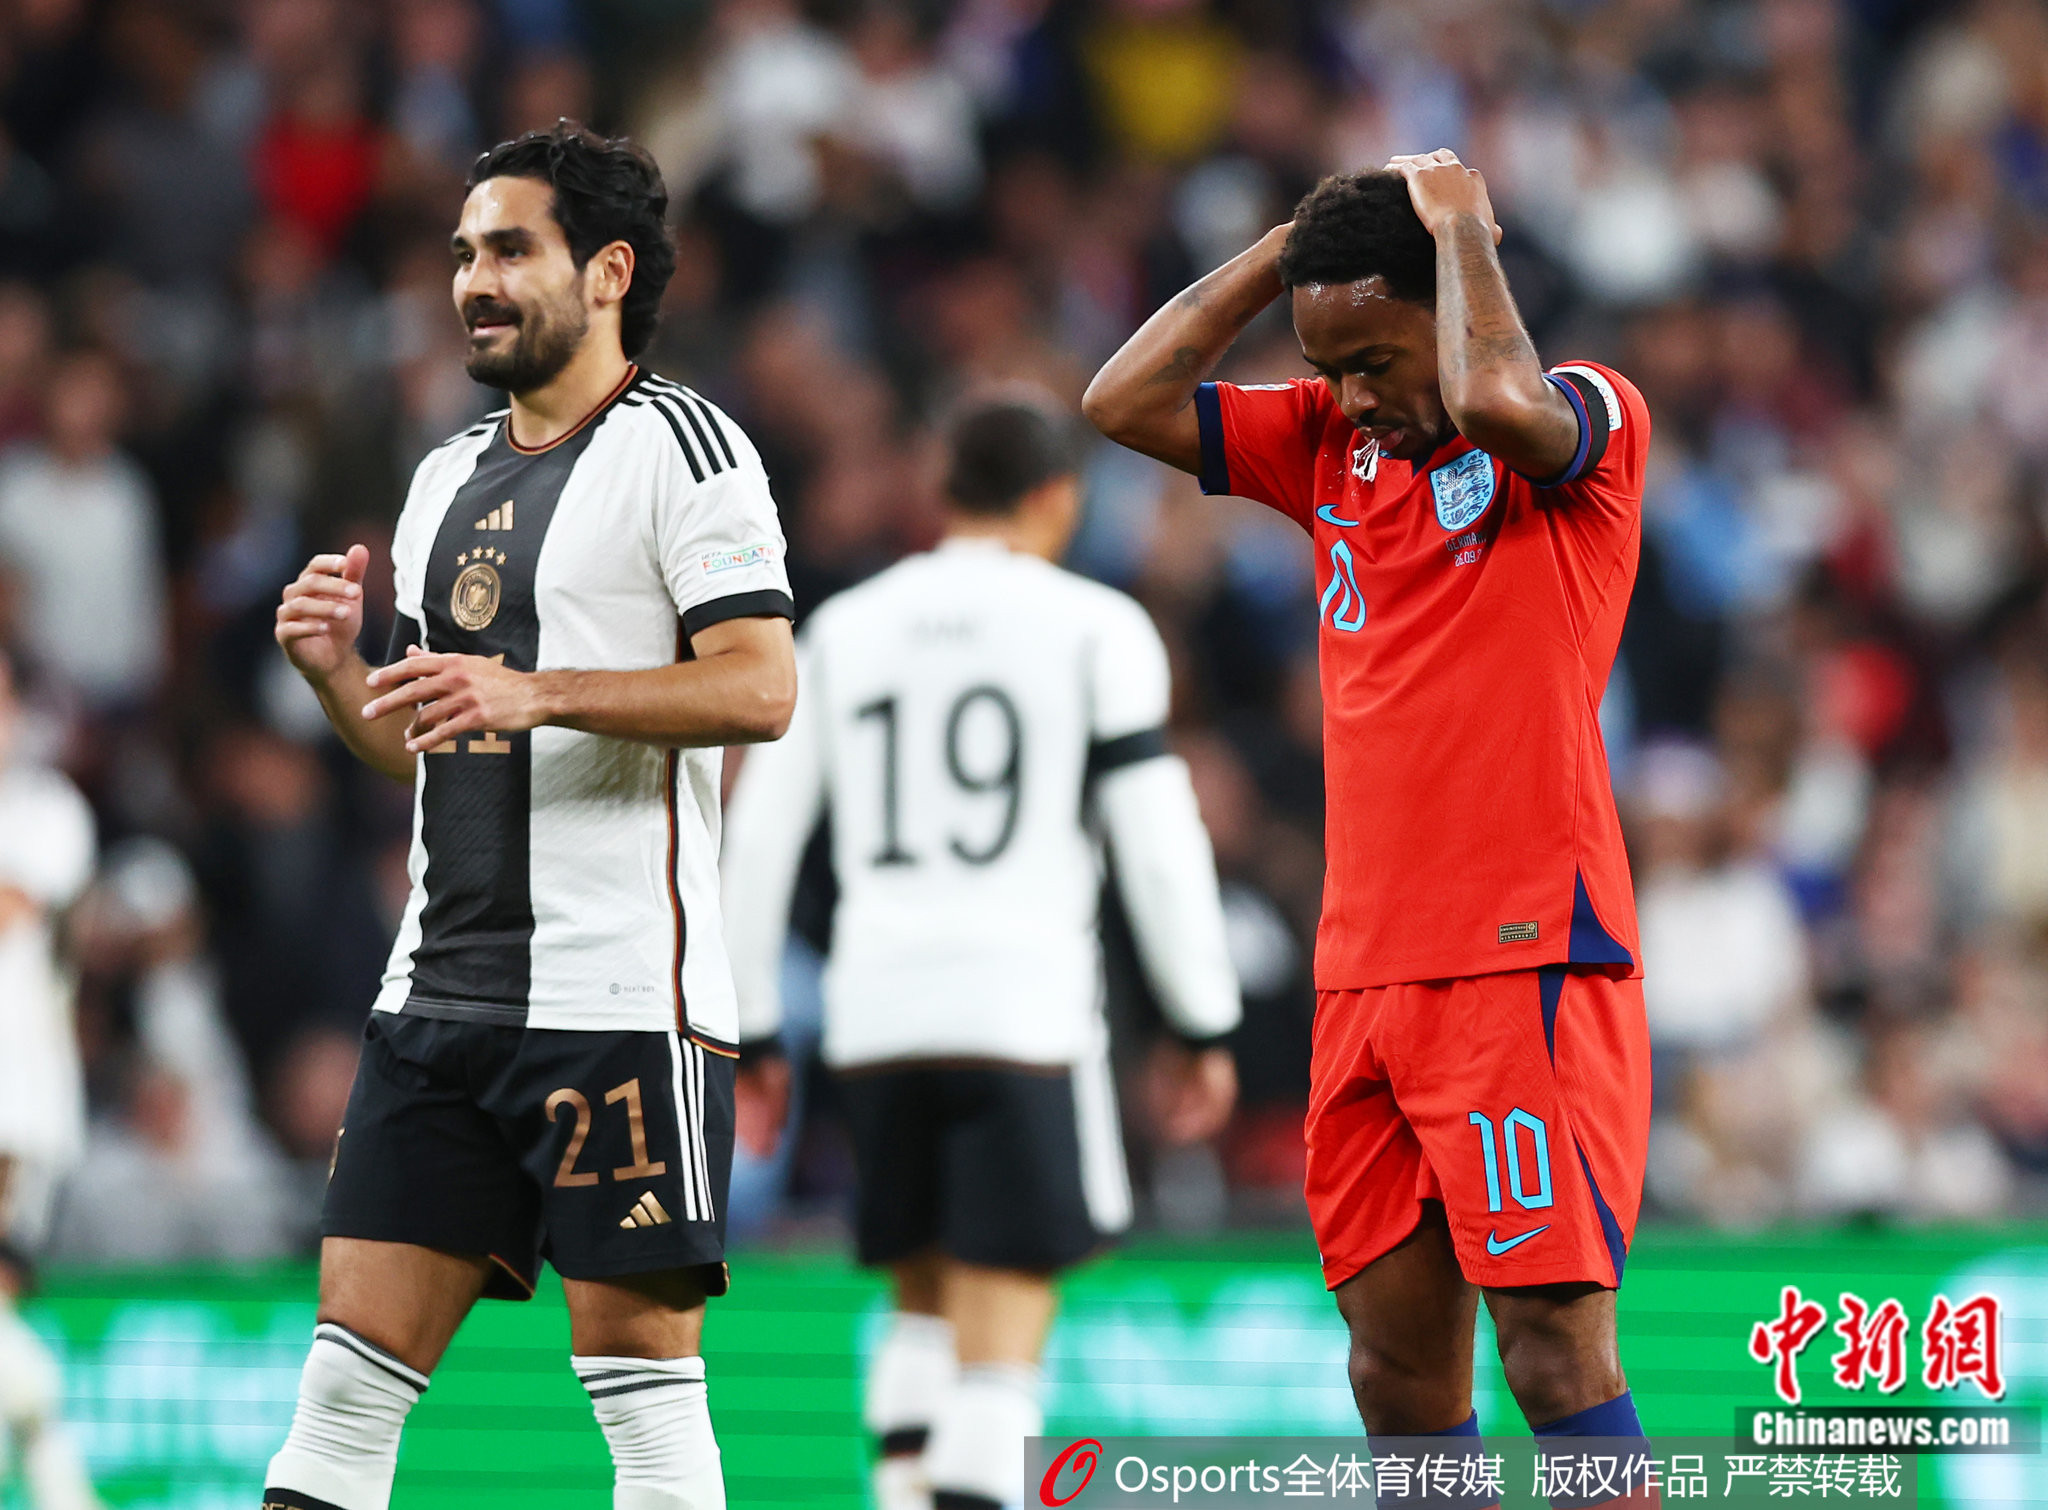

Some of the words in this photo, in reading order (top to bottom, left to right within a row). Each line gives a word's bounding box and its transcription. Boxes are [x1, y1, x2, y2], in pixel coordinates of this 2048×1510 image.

[1445, 532, 1487, 551] GERMA
[851, 681, 1024, 869] 19
[544, 1077, 667, 1188] 21
[1468, 1107, 1554, 1213] 10
